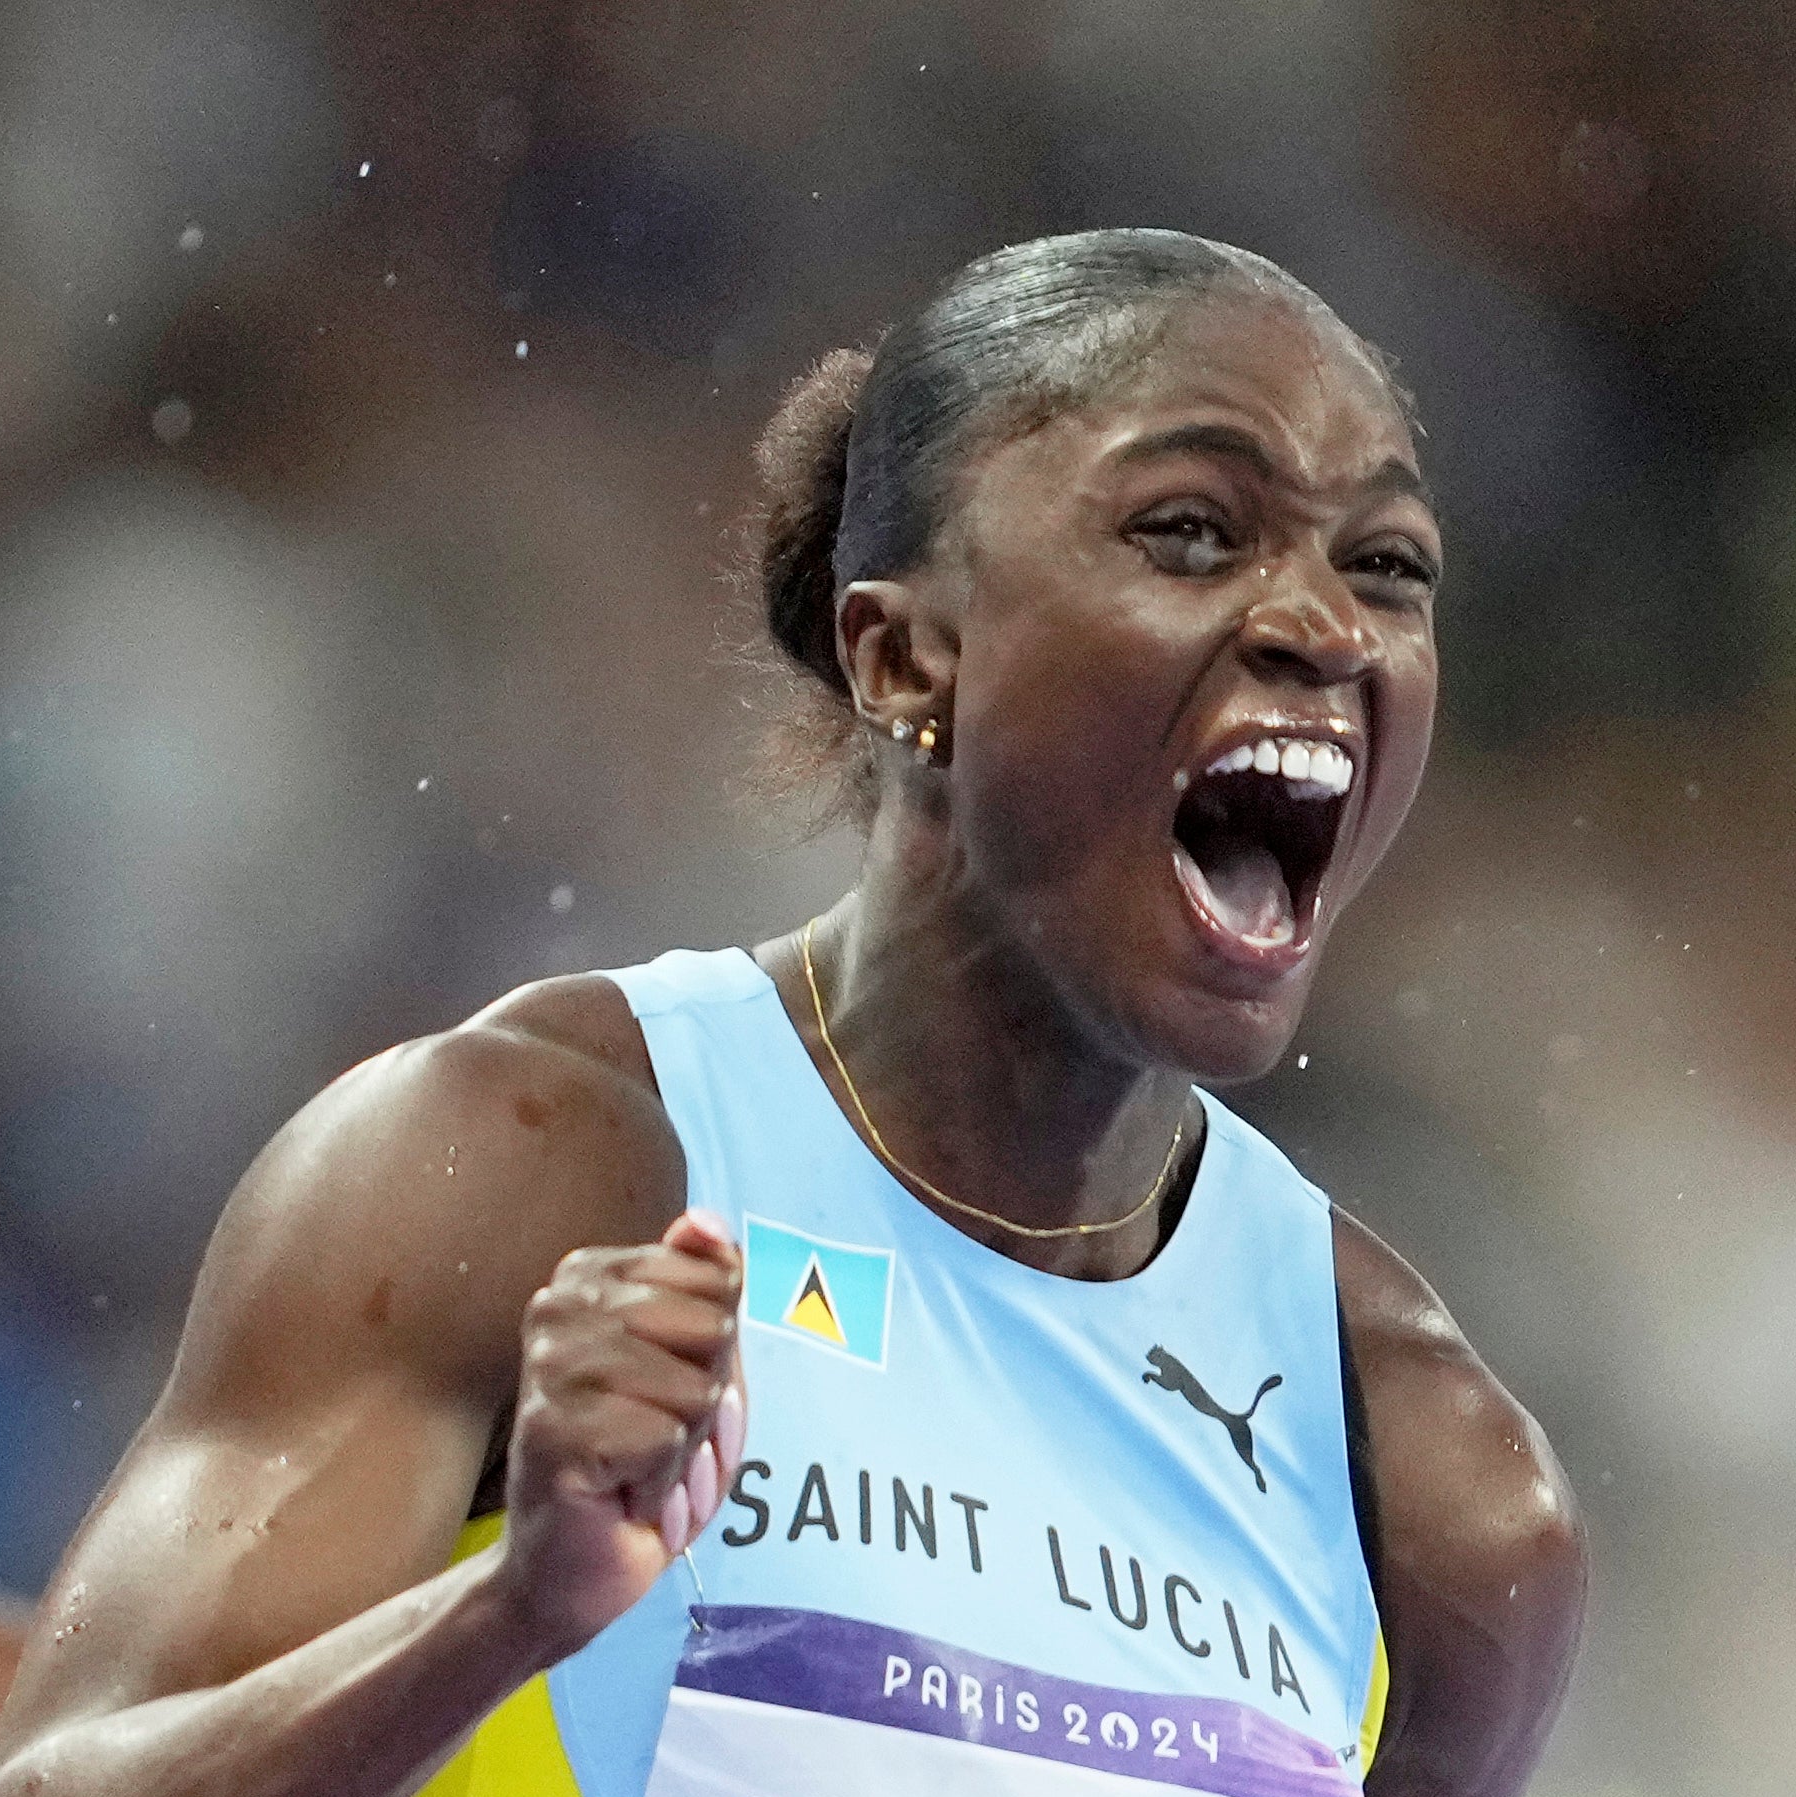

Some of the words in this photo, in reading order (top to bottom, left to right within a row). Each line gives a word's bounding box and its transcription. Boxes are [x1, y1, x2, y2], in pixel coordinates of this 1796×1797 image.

[721, 1458, 990, 1574] SAINT
[1045, 1524, 1312, 1716] LUCIA
[882, 1653, 1041, 1734] PARIS
[1062, 1702, 1220, 1765] 2024
